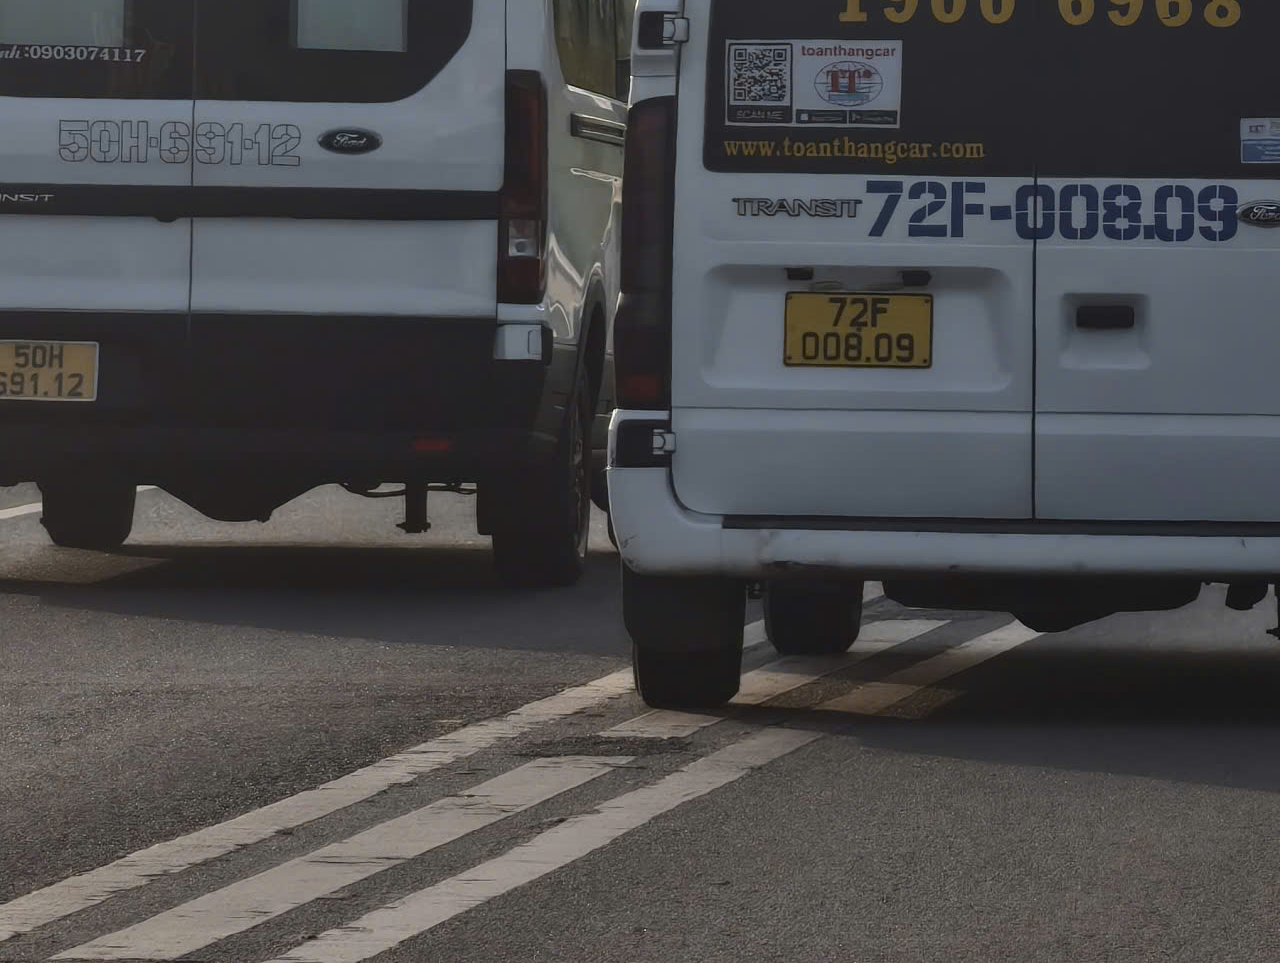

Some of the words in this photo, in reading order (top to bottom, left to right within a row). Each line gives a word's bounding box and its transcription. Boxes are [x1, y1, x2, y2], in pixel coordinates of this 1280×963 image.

[801, 45, 896, 60] toanthangcar
[723, 136, 985, 164] www.toanthangcar.com
[0, 193, 55, 203] NSIT
[732, 197, 863, 218] TRANSIT
[866, 180, 1238, 242] 72F-008.09
[828, 297, 890, 328] 72F
[15, 344, 63, 369] 50H
[802, 331, 914, 363] 008.09
